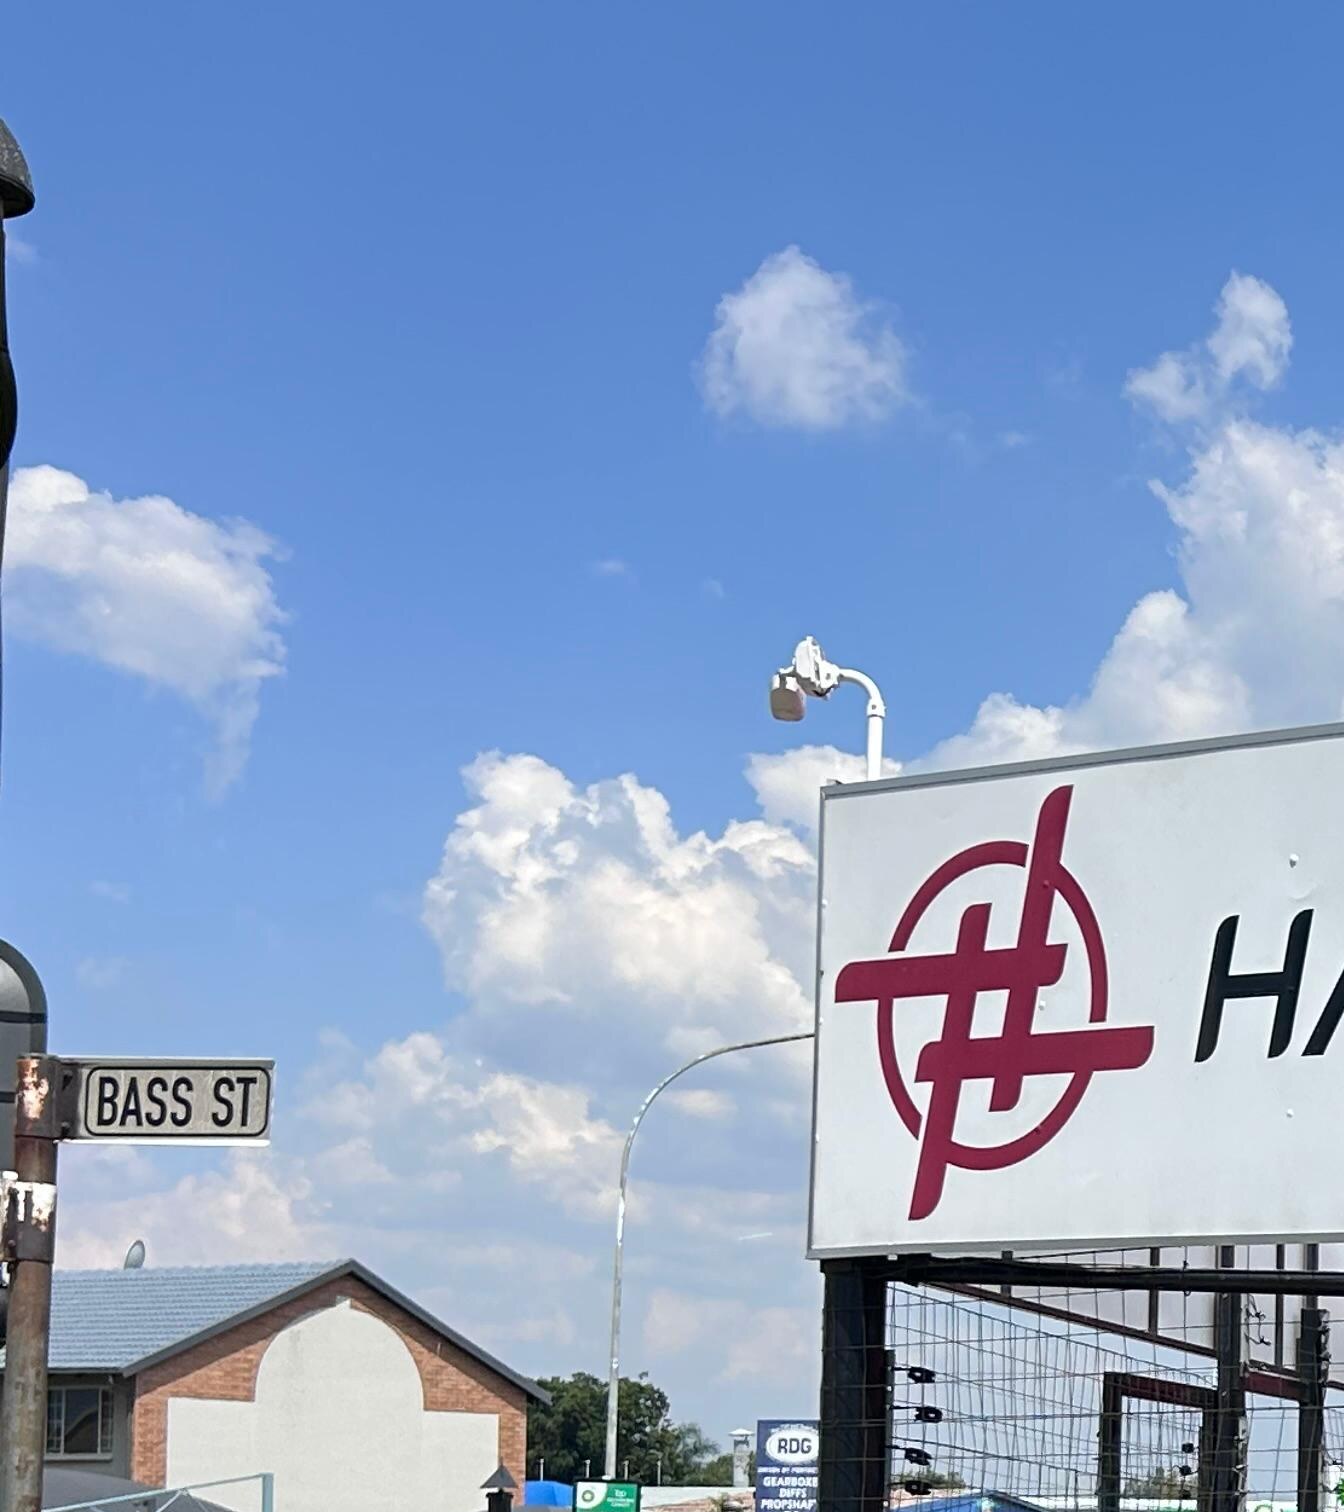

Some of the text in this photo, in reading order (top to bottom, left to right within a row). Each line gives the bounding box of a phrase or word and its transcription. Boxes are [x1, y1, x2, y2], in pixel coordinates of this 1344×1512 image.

[97, 1076, 258, 1127] BASS ST
[777, 1437, 812, 1454] RDG
